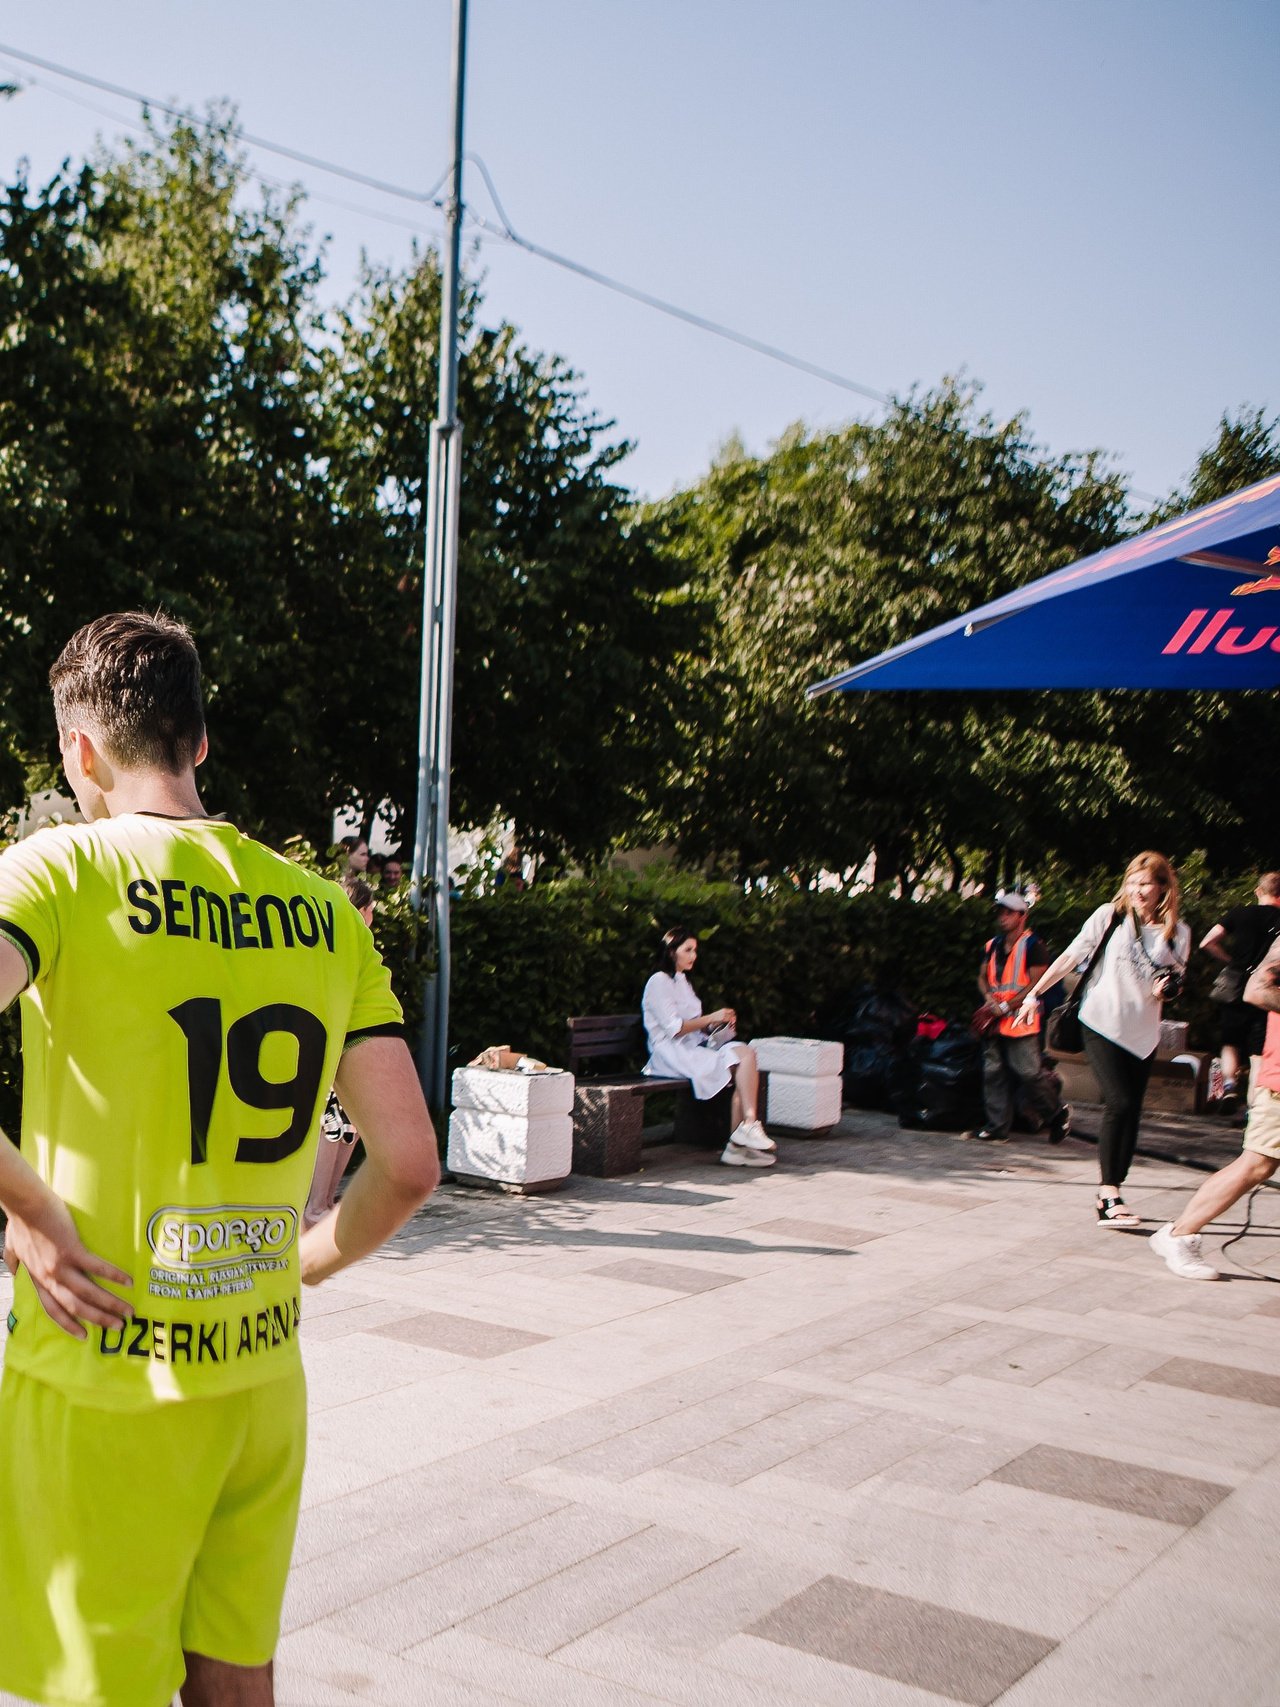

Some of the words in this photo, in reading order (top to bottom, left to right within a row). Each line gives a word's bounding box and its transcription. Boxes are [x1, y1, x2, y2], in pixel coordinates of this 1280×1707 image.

[126, 878, 336, 954] SEMENOV
[167, 997, 328, 1166] 19
[148, 1282, 182, 1299] FROM
[150, 1267, 206, 1286] ORIGINAL
[208, 1265, 245, 1283] RUSSIAN
